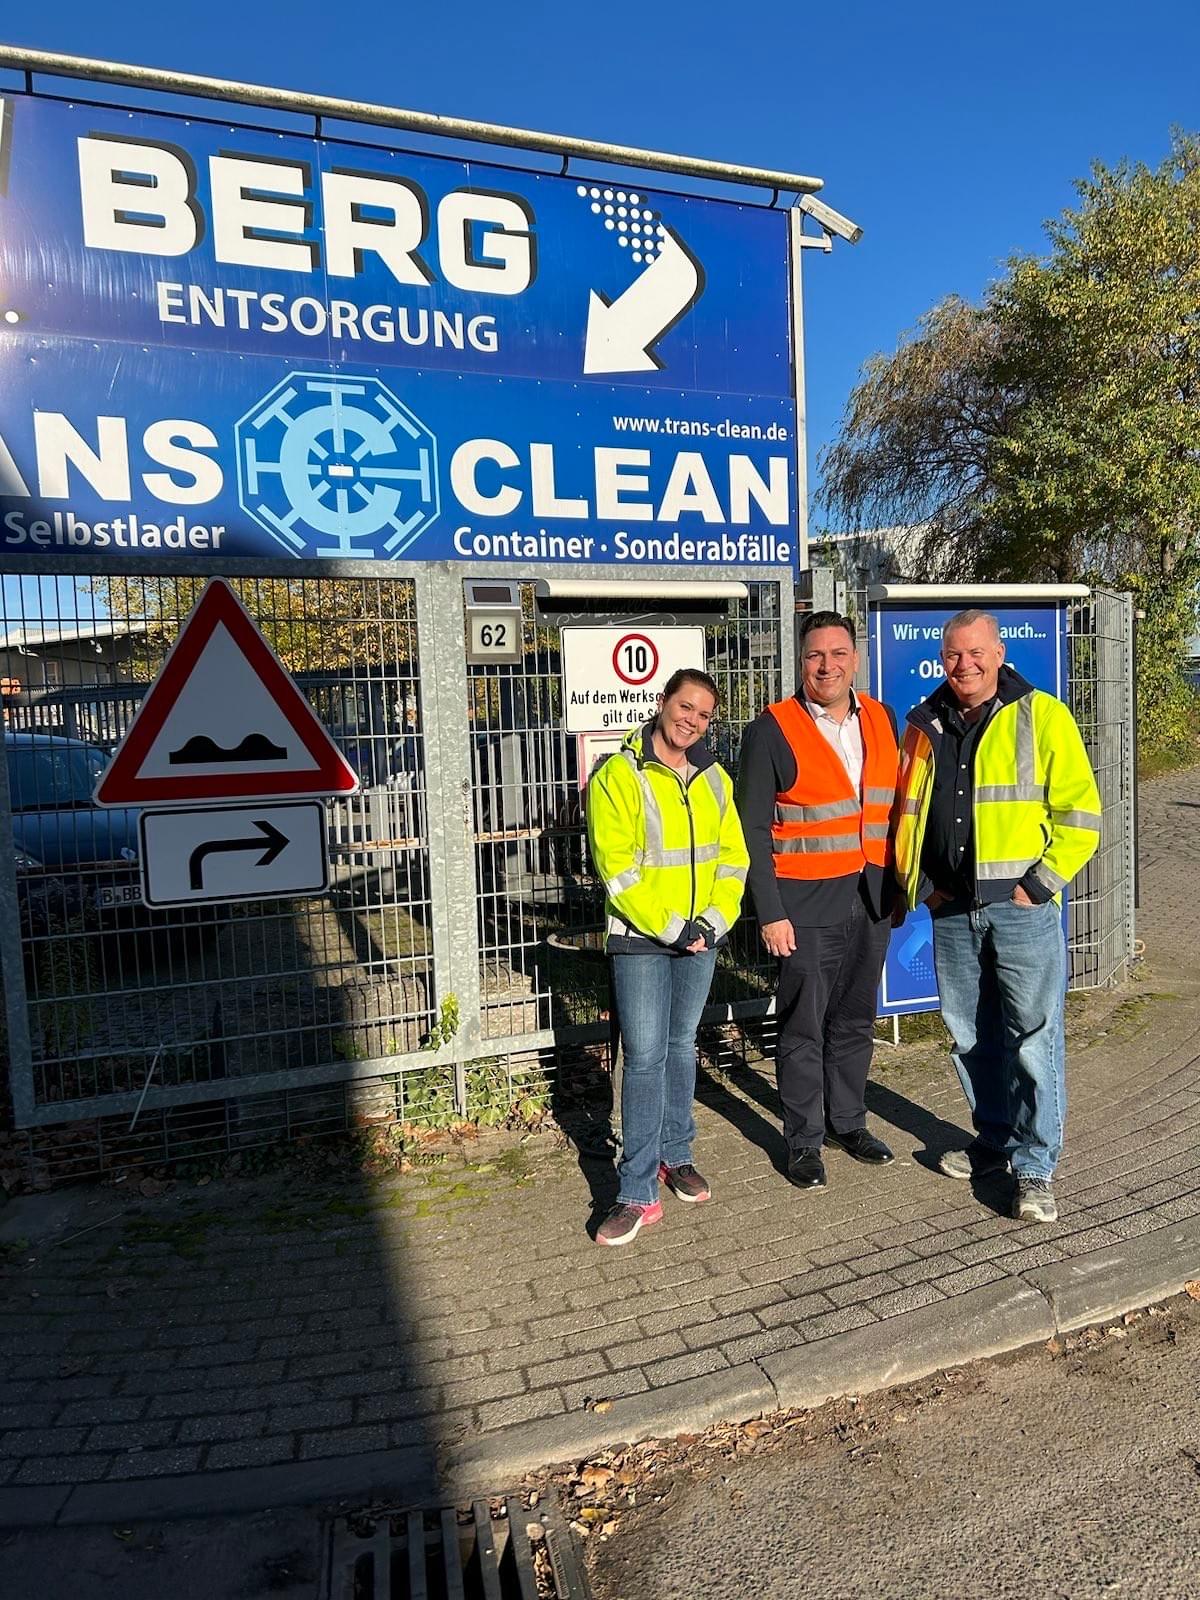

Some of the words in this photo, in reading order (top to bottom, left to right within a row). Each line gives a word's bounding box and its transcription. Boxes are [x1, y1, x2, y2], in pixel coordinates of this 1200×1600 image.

[77, 132, 534, 297] BERG
[156, 281, 499, 353] ENTSORGUNG
[613, 416, 788, 441] www.trans-clean.de
[450, 438, 790, 526] CLEAN
[4, 511, 226, 549] Selbstlader
[453, 526, 594, 559] Container
[614, 531, 790, 563] Sonderabfälle
[480, 623, 506, 647] 62
[892, 623, 920, 641] Wir
[1000, 622, 1047, 639] auch...
[624, 645, 647, 673] 10
[919, 659, 947, 679] Ob
[570, 690, 590, 705] Auf
[592, 690, 617, 704] dem
[602, 709, 623, 727] gilt
[626, 709, 644, 723] die
